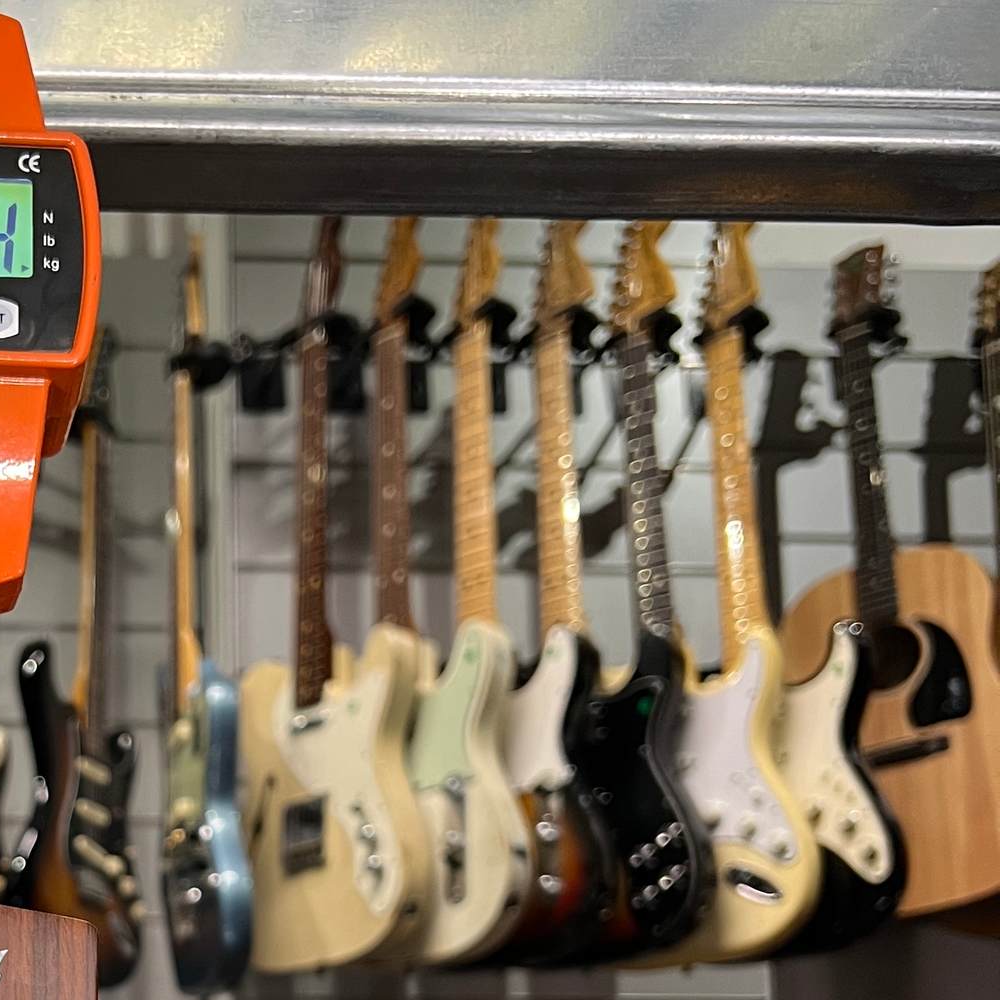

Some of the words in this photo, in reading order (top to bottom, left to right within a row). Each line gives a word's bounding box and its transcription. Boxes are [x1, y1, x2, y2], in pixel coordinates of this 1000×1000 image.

[18, 154, 41, 173] CE
[43, 210, 54, 224] N
[43, 234, 55, 247] lb
[43, 256, 60, 272] kg
